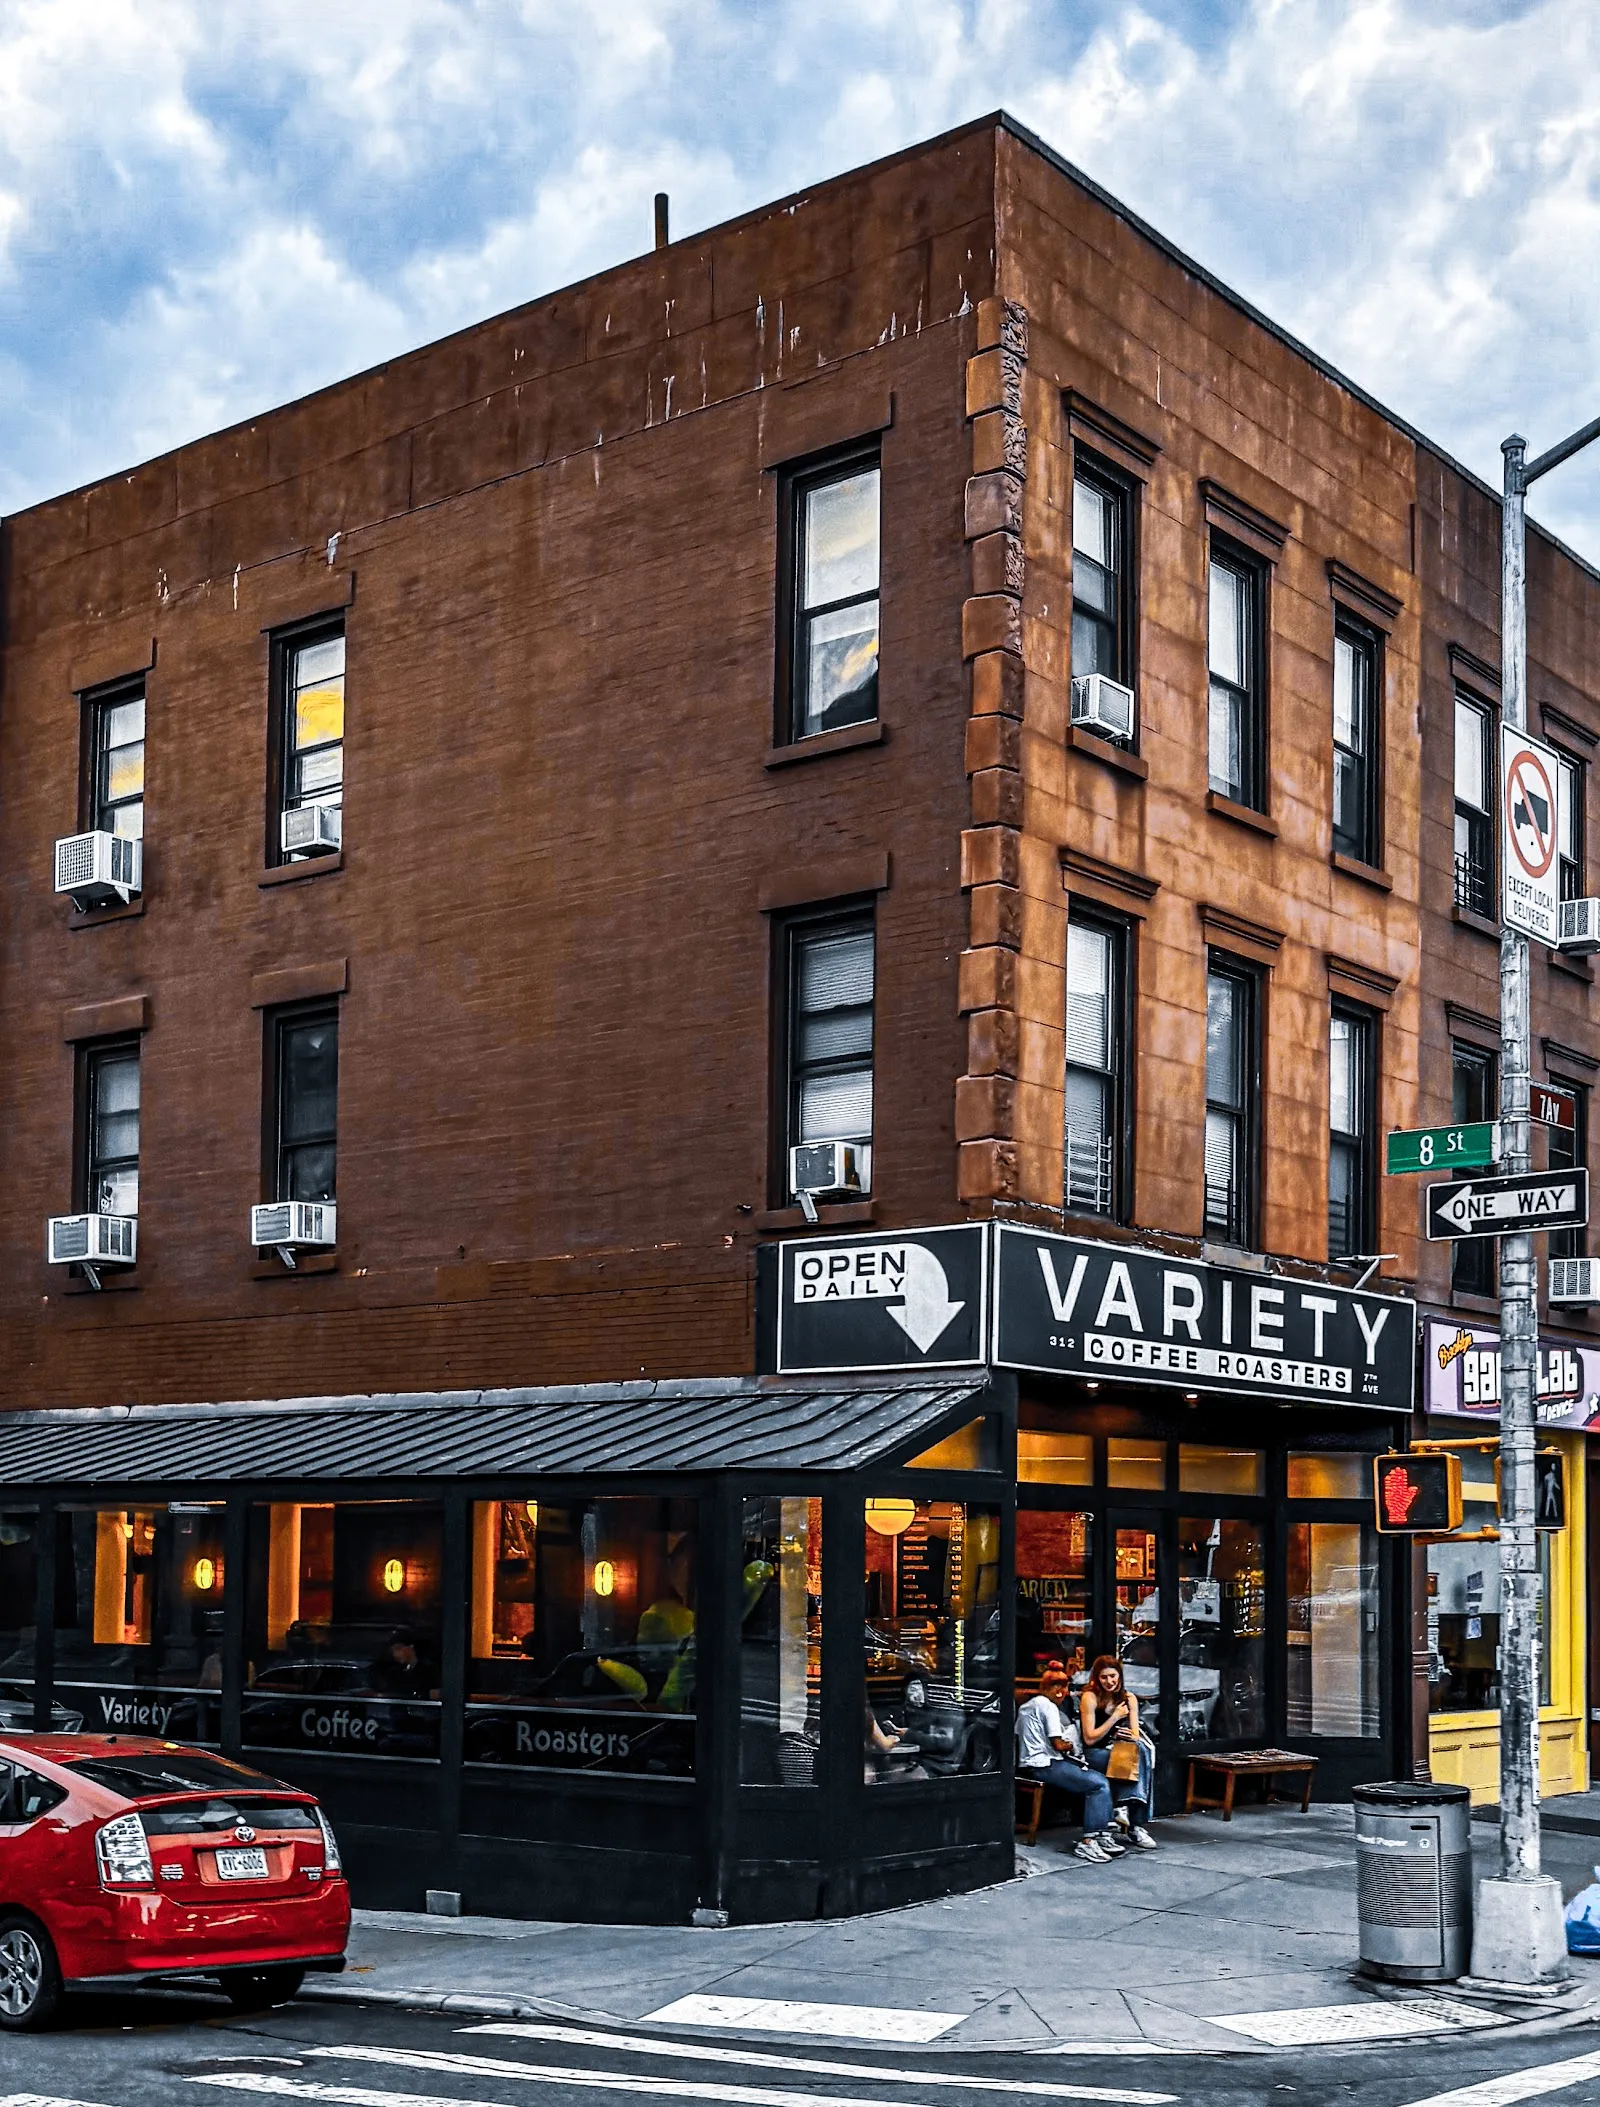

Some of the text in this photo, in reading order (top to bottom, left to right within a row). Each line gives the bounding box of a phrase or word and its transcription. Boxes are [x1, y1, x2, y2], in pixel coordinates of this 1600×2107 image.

[1419, 1131, 1465, 1166] 8 St
[1452, 1188, 1566, 1220] ONE WAY
[801, 1250, 906, 1280] OPEN
[803, 1276, 905, 1299] DAILY
[1036, 1247, 1391, 1366] VARIETY
[1049, 1335, 1076, 1349] 312
[1090, 1338, 1347, 1389] COFFEE ROASTERS
[1362, 1384, 1379, 1395] AVE
[1018, 1579, 1070, 1599] ARIETY
[99, 1695, 173, 1735] Variety
[301, 1707, 380, 1741] Coffee
[516, 1720, 630, 1757] Roasters
